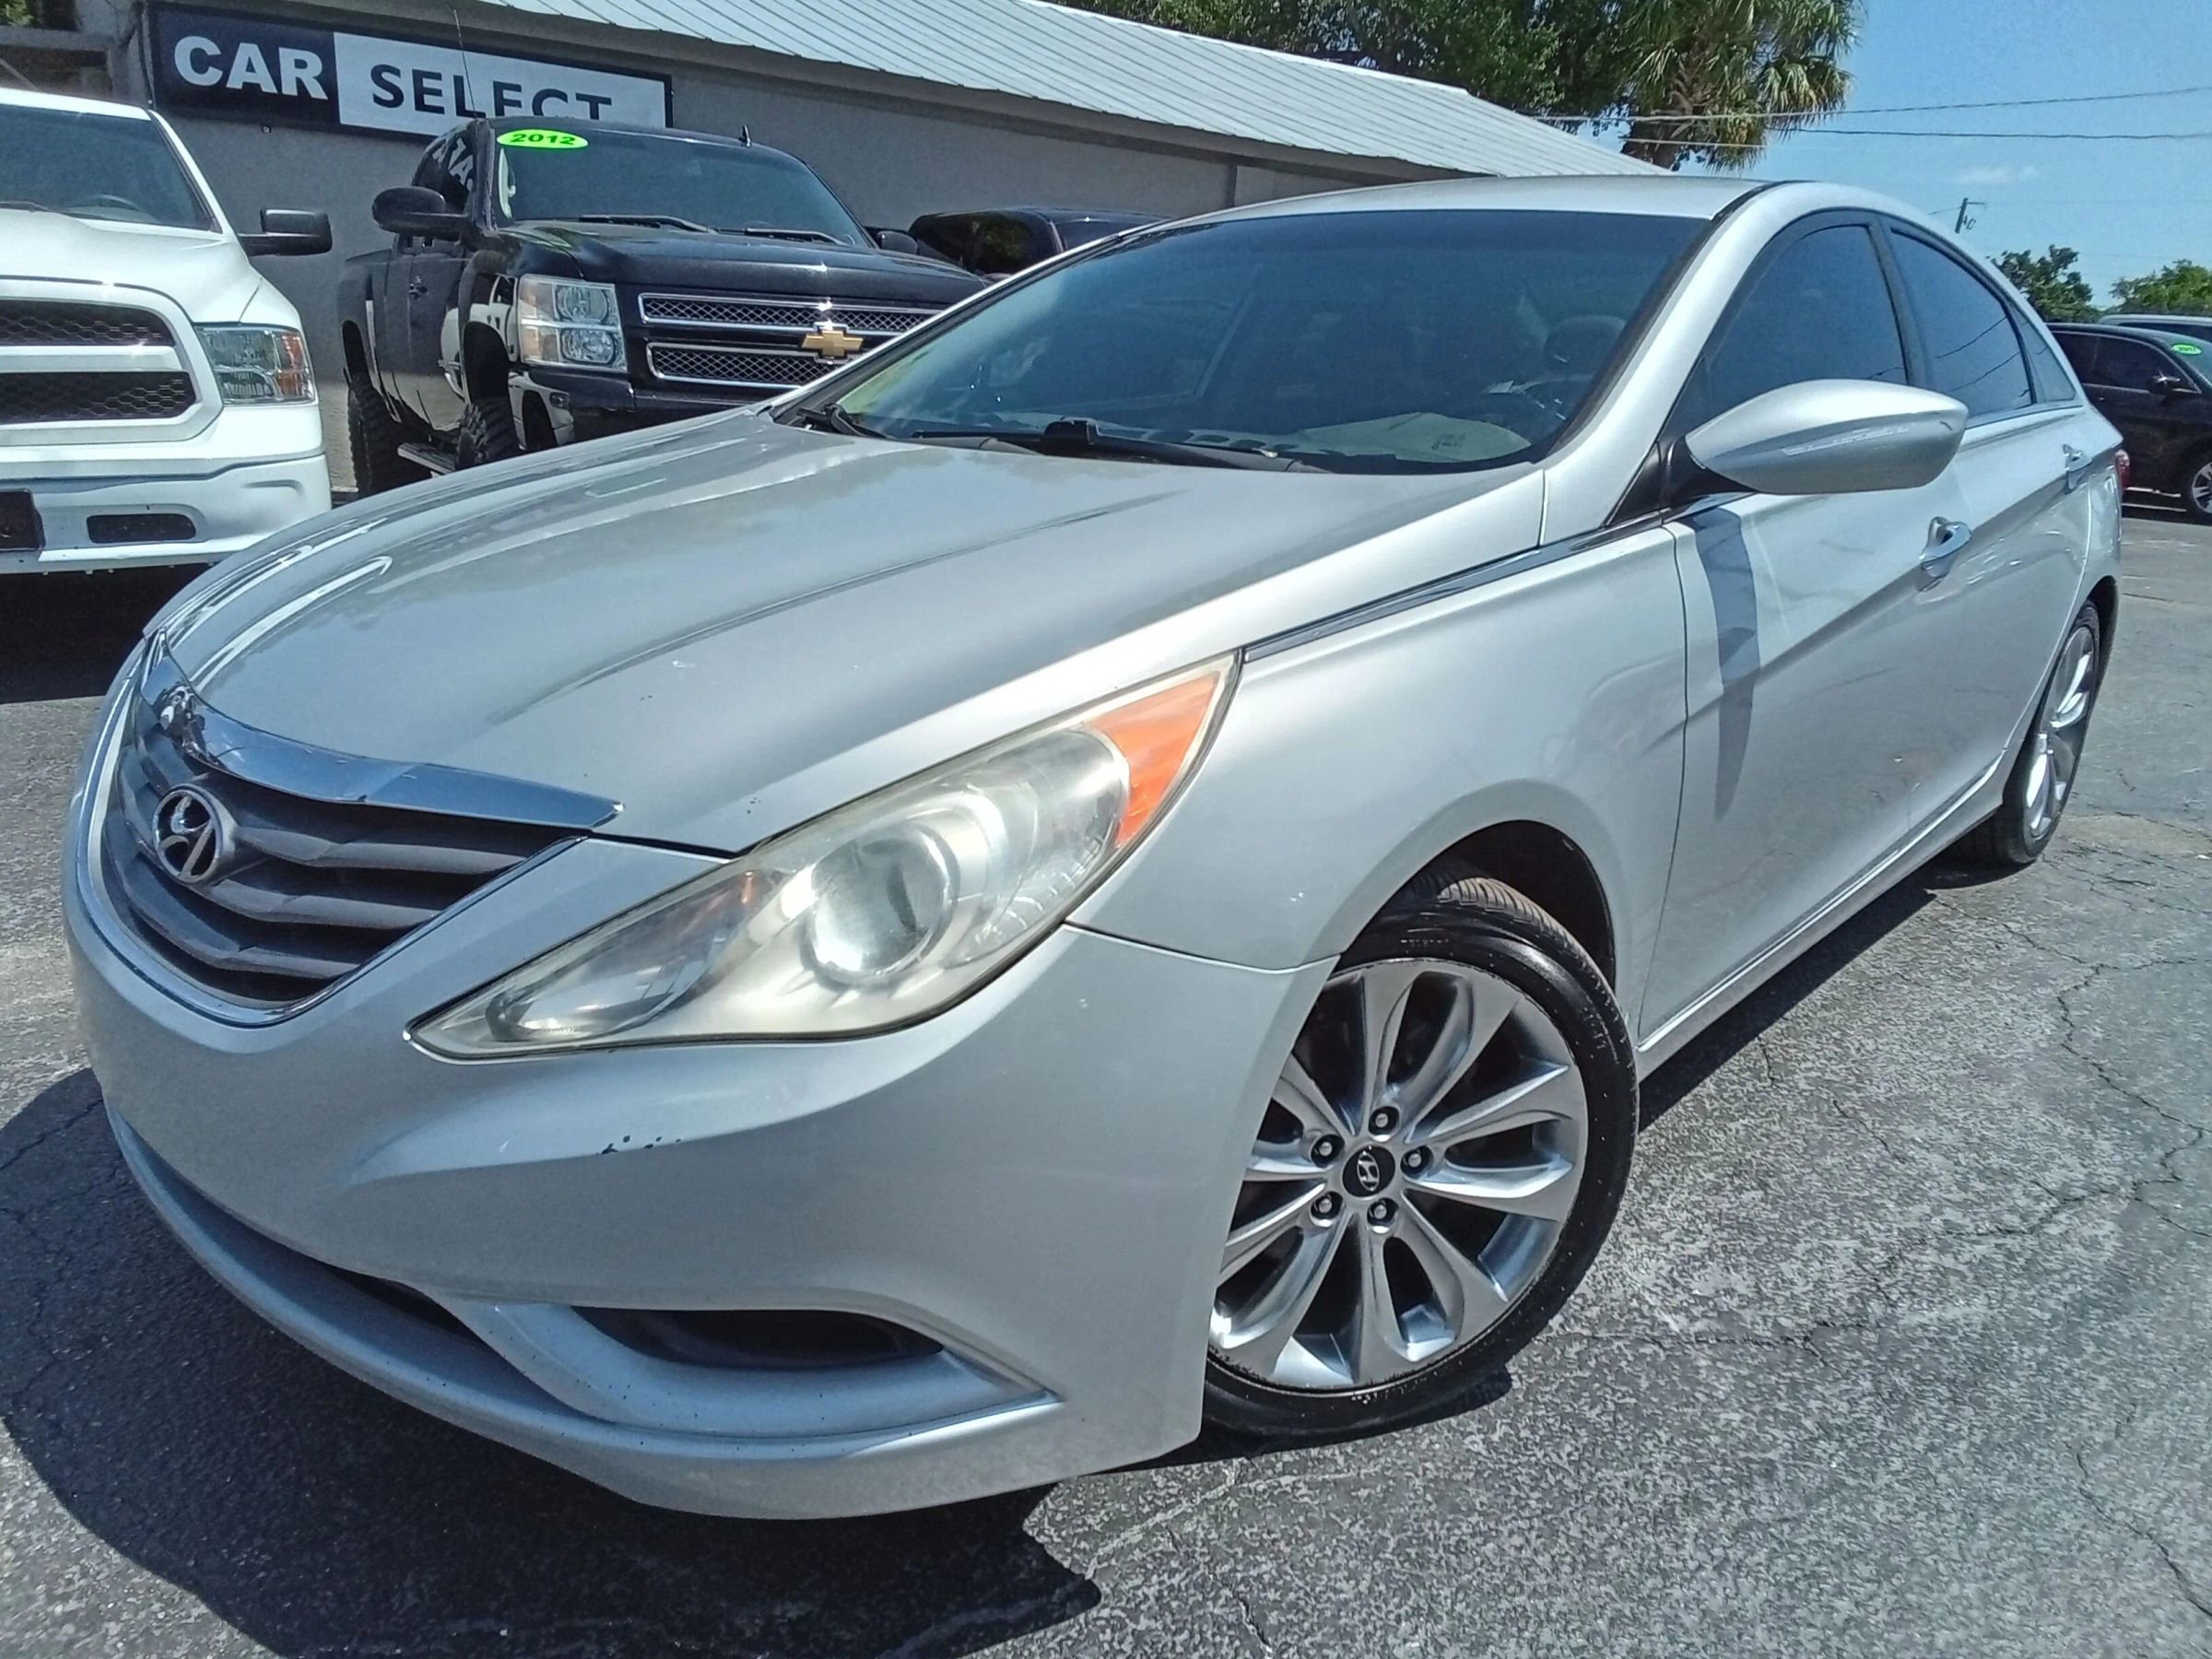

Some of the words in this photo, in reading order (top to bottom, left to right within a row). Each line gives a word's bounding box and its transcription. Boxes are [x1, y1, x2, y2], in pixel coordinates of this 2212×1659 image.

[174, 35, 329, 100] CAR
[370, 64, 613, 121] SELECT
[510, 133, 576, 146] 2012
